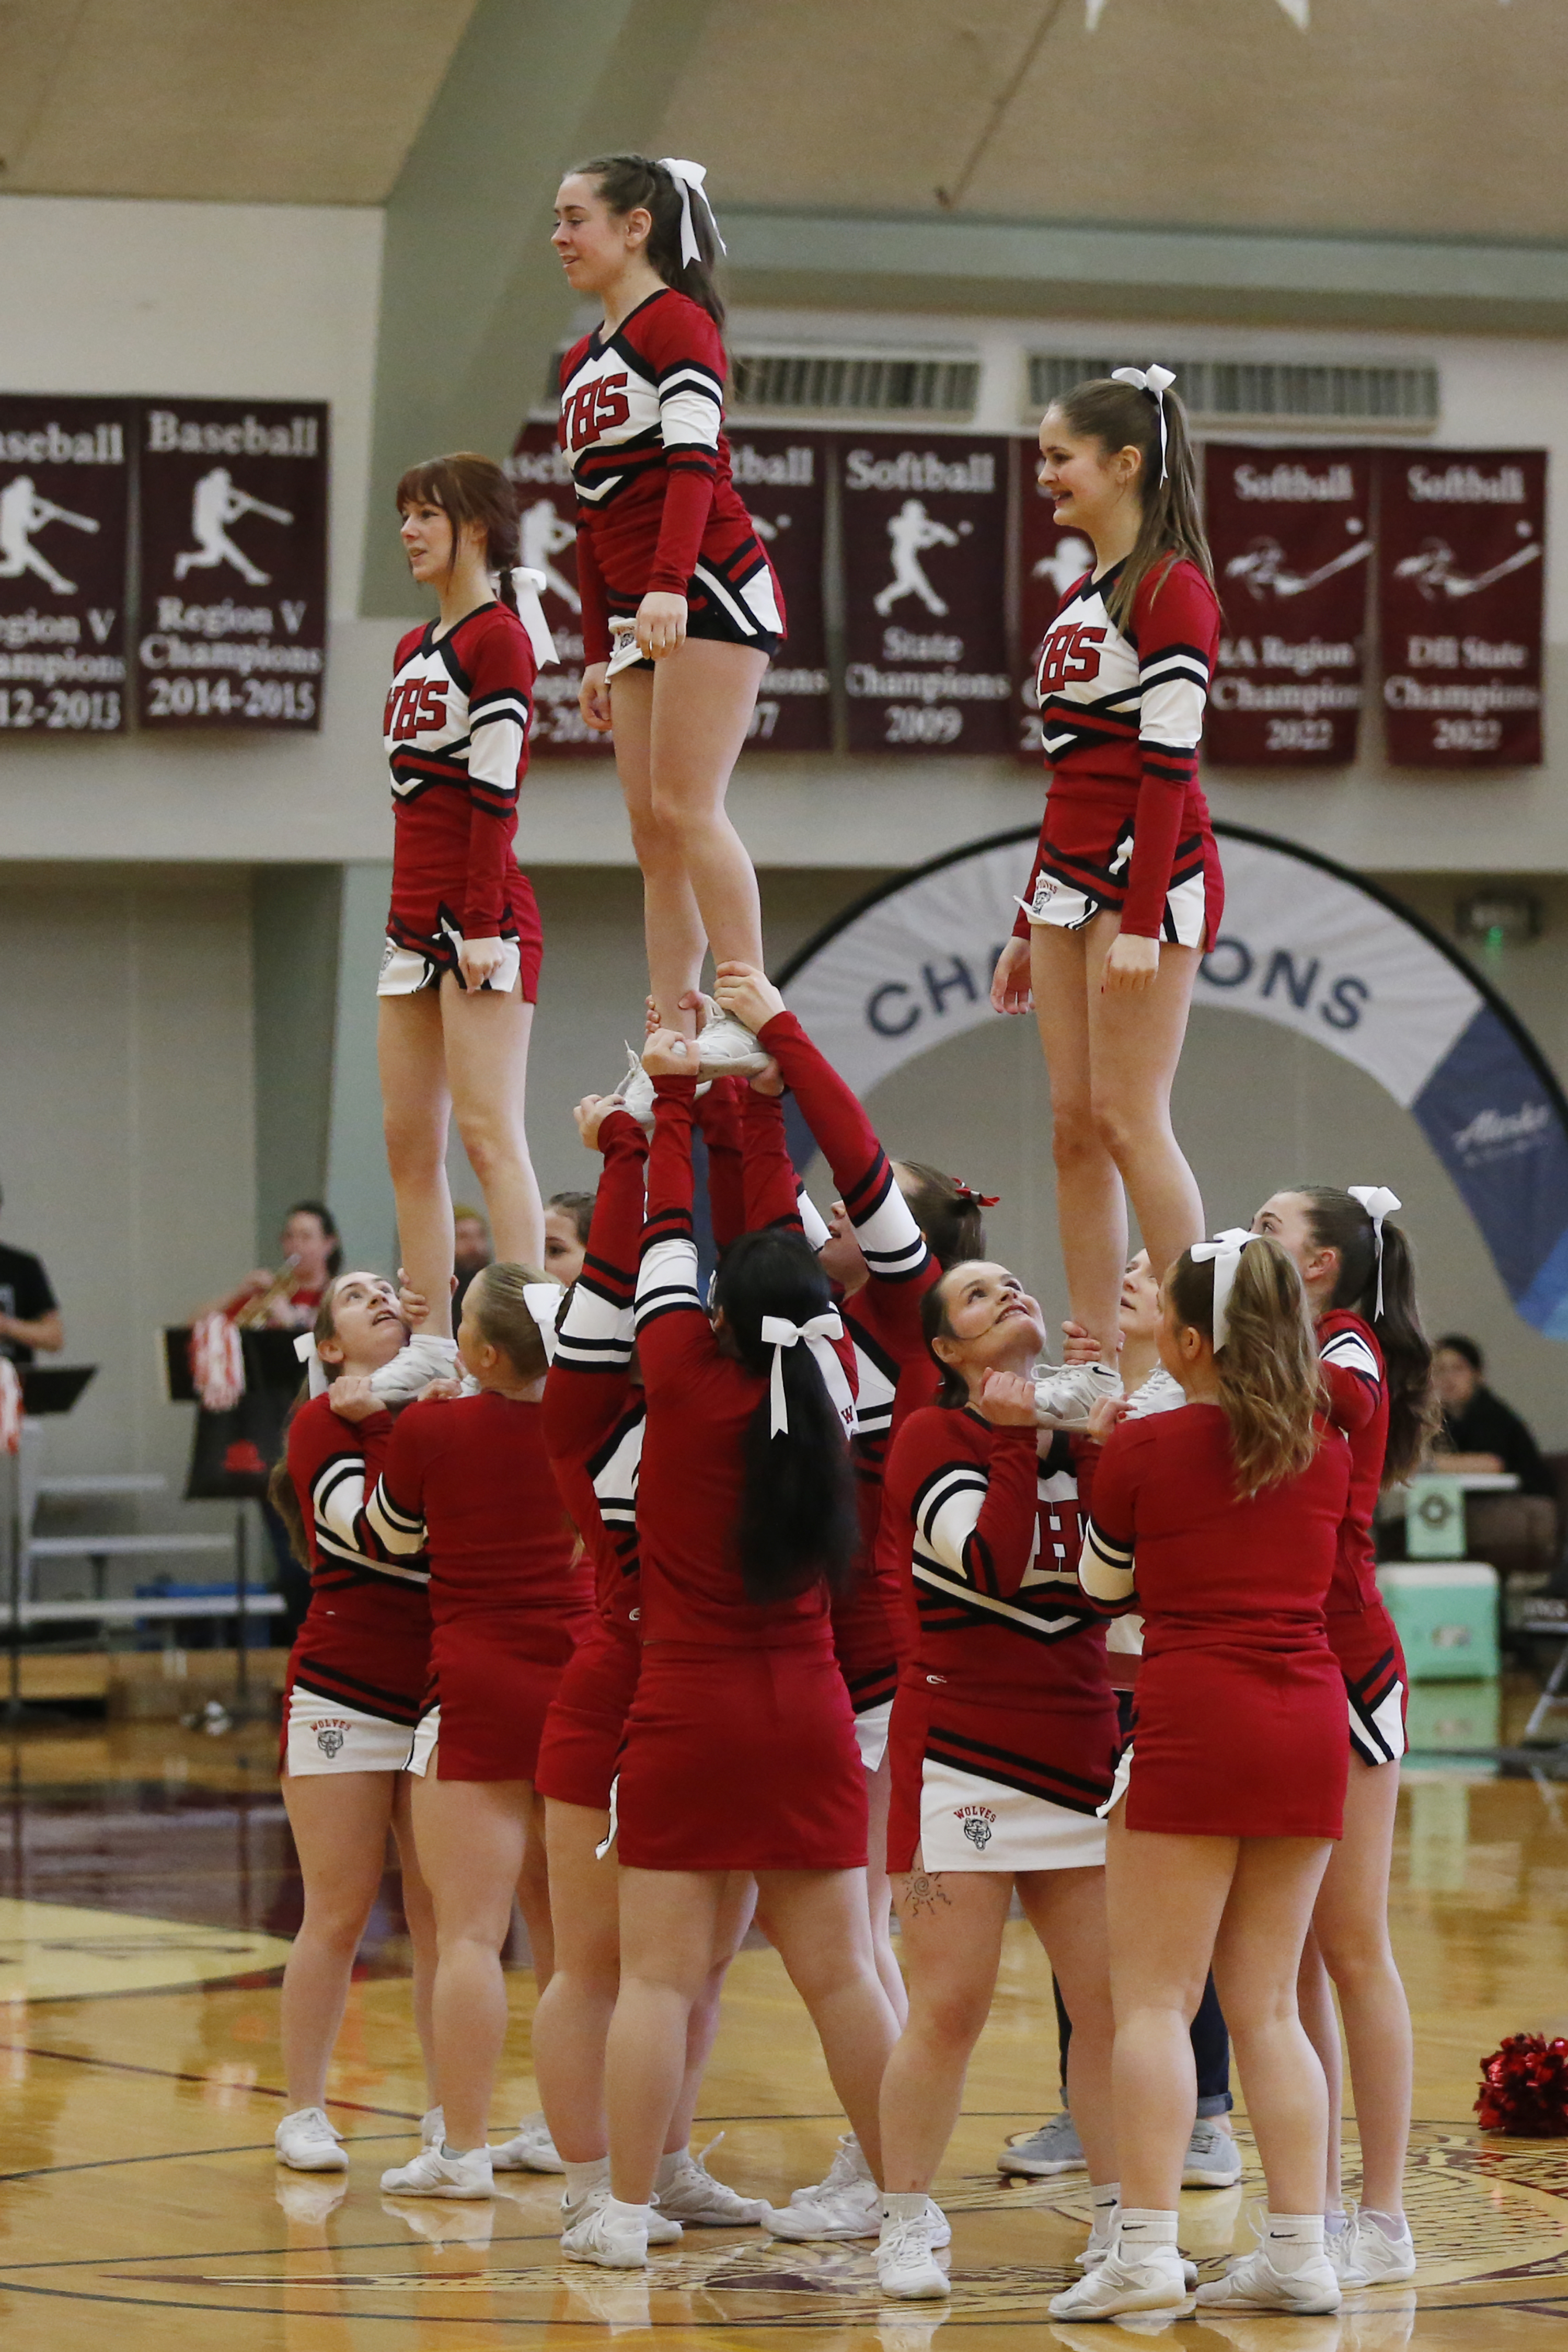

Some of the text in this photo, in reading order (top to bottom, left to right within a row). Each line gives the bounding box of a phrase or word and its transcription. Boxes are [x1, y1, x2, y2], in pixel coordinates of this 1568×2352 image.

[0, 422, 124, 464] seball
[149, 410, 317, 458] Baseball
[846, 448, 996, 493] Softball
[1234, 464, 1353, 501] Softball
[1408, 465, 1525, 502] Softball
[87, 608, 116, 644] V
[158, 596, 307, 638] Region V
[139, 633, 322, 677] Champions
[883, 626, 963, 662] State
[1036, 621, 1108, 695] HS
[1261, 636, 1355, 676] Region
[148, 677, 316, 721] 2014-2015
[845, 663, 1012, 703] Champions
[841, 1404, 854, 1424] W
[310, 1719, 351, 1732] WOLVES
[953, 1806, 996, 1823] WOLVES
